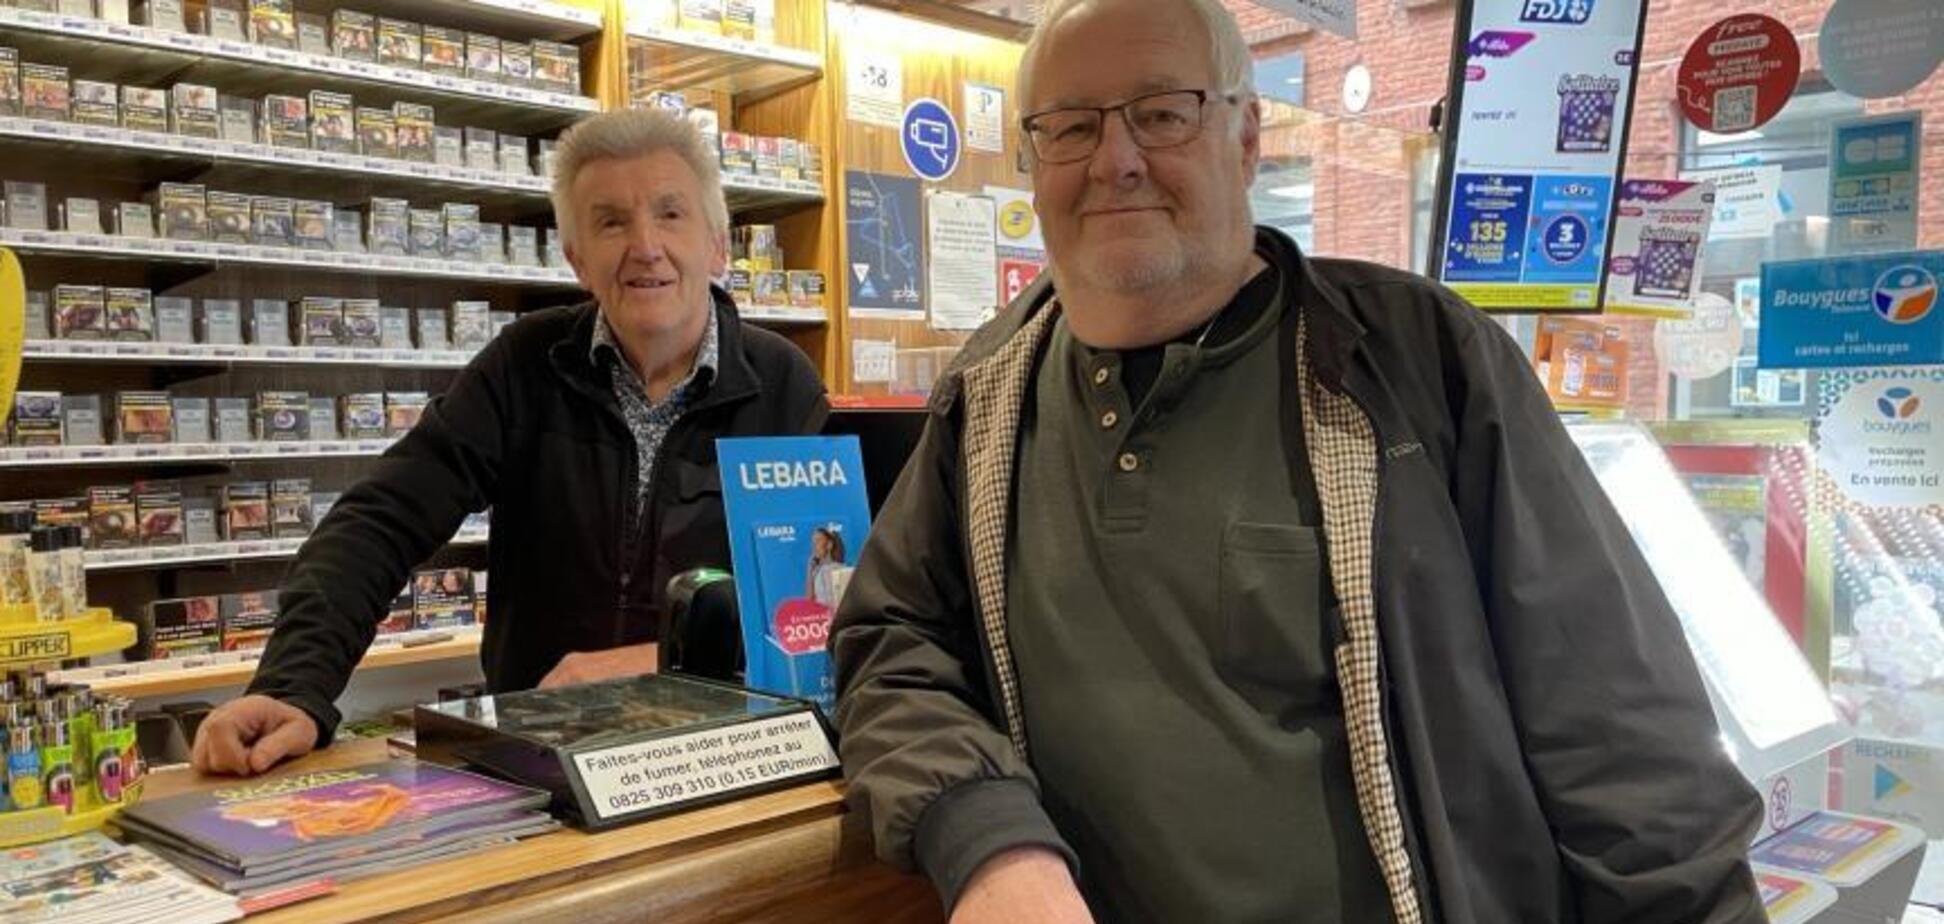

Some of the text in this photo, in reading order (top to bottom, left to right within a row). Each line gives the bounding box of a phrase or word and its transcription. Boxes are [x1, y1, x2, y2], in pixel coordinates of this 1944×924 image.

[1523, 0, 1566, 19] FDJ
[1716, 19, 1763, 38] free
[1558, 74, 1620, 93] Solitaire
[1469, 220, 1508, 242] 135
[1558, 223, 1574, 243] 3
[1773, 287, 1871, 310] Bouygues
[1795, 340, 1910, 357] cartes et recharges
[739, 458, 848, 490] LEBARA
[1850, 472, 1871, 485] En
[1873, 475, 1918, 486] vente
[757, 525, 796, 538] LEBARA
[586, 718, 812, 772] Faites-vous aider pour arrêter
[620, 771, 641, 787] de
[699, 744, 781, 771] téléphonez
[784, 740, 802, 752] au
[609, 790, 651, 810] 0825
[655, 782, 684, 799] 309
[687, 776, 716, 793] 310
[759, 754, 826, 778] EUR/min)
